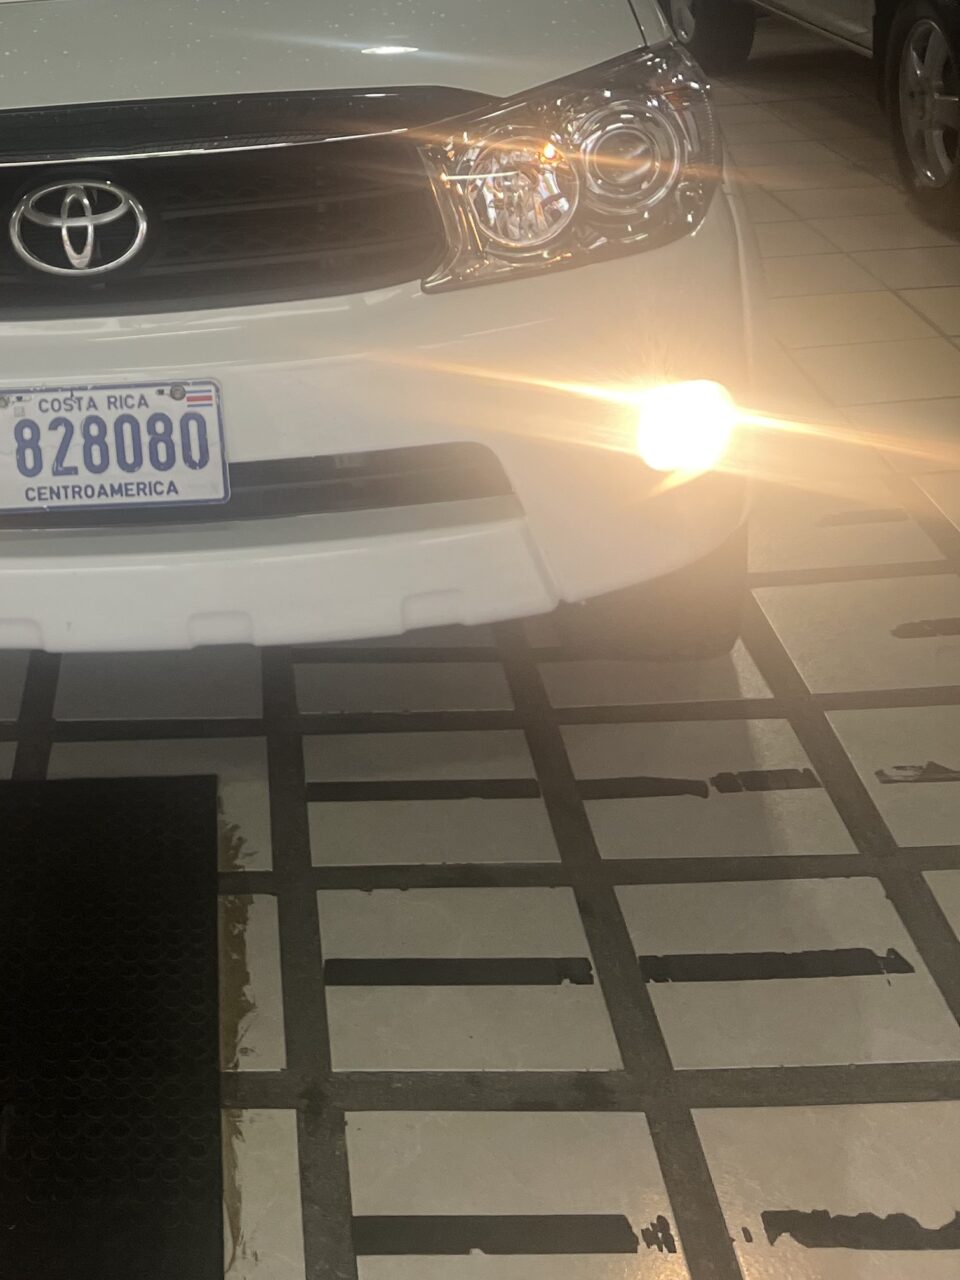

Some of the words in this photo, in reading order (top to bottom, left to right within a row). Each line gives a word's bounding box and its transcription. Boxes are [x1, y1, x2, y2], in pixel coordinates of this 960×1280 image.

[38, 395, 98, 413] COSTA
[107, 394, 149, 411] RICA
[13, 411, 210, 478] 828080
[25, 480, 179, 502] CENTROAMERICA
